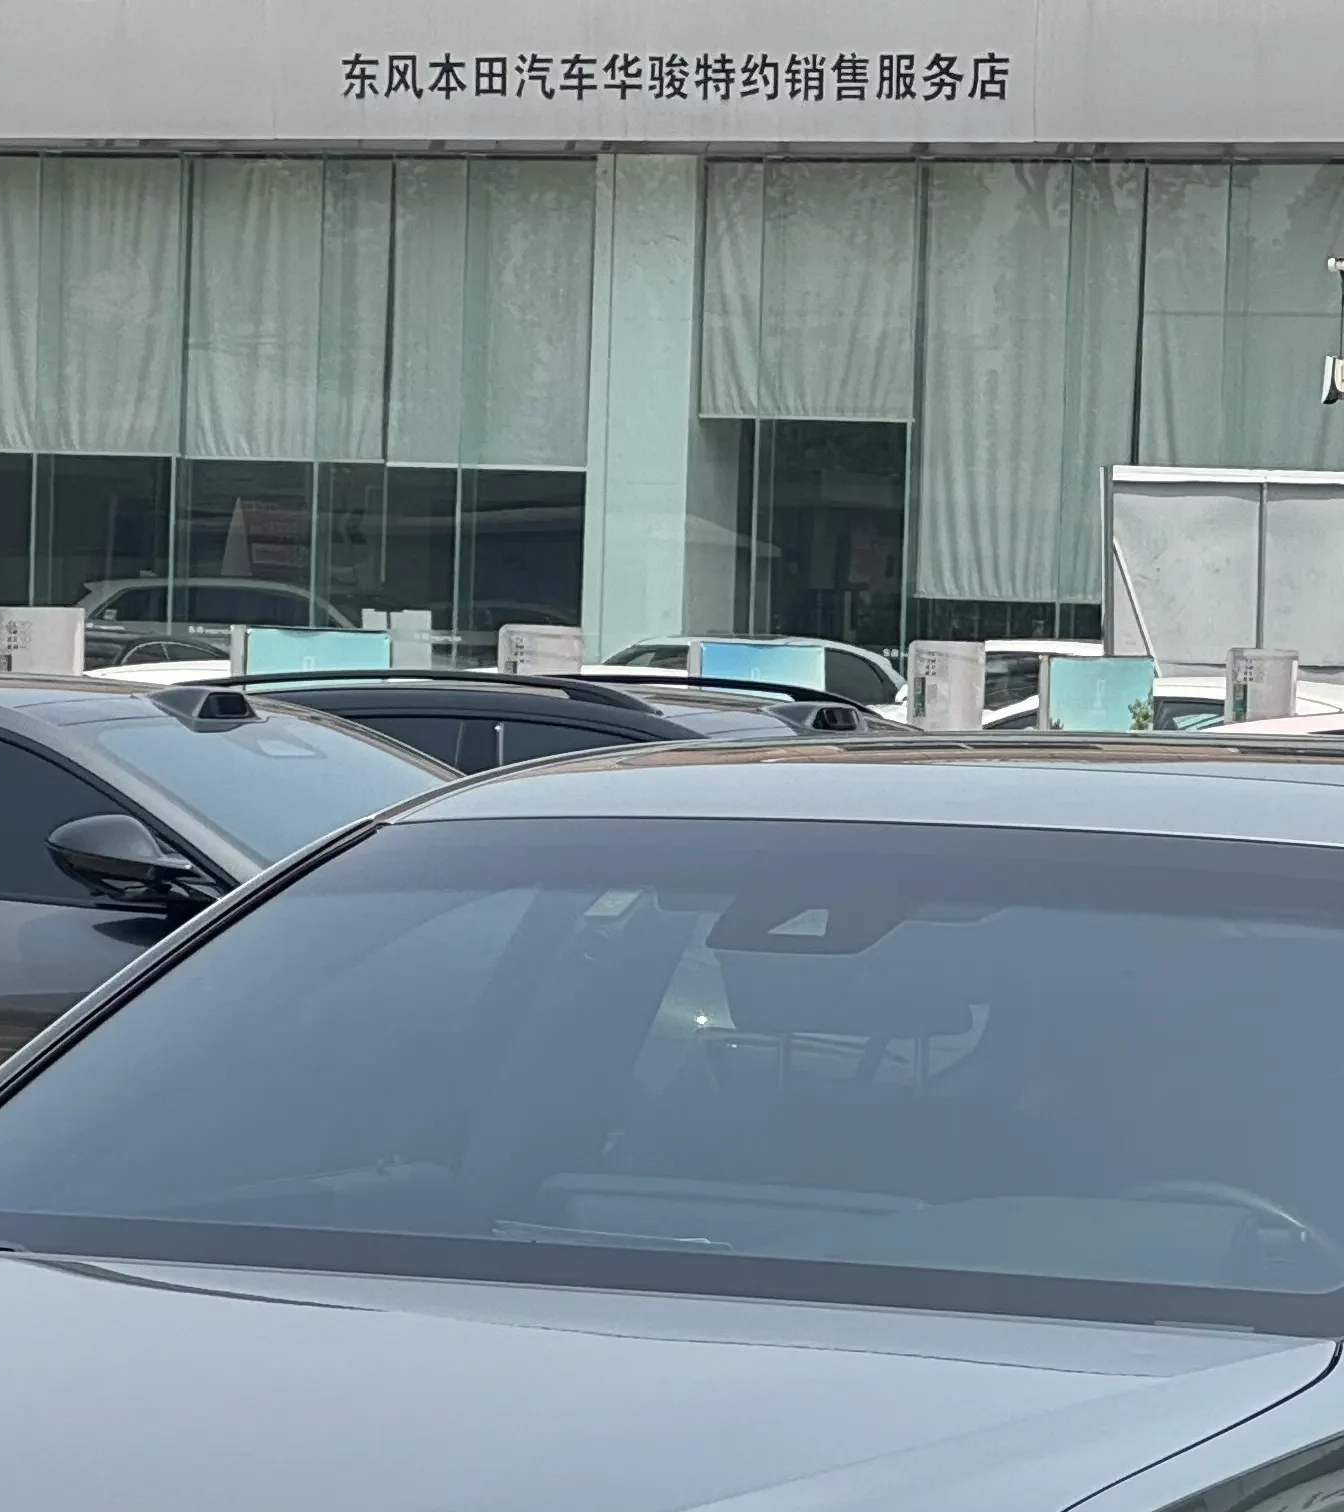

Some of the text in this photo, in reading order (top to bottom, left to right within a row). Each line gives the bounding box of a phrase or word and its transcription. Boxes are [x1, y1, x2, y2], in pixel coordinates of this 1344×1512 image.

[341, 52, 1011, 102] 东风本田汽车华骏特约销售服务店
